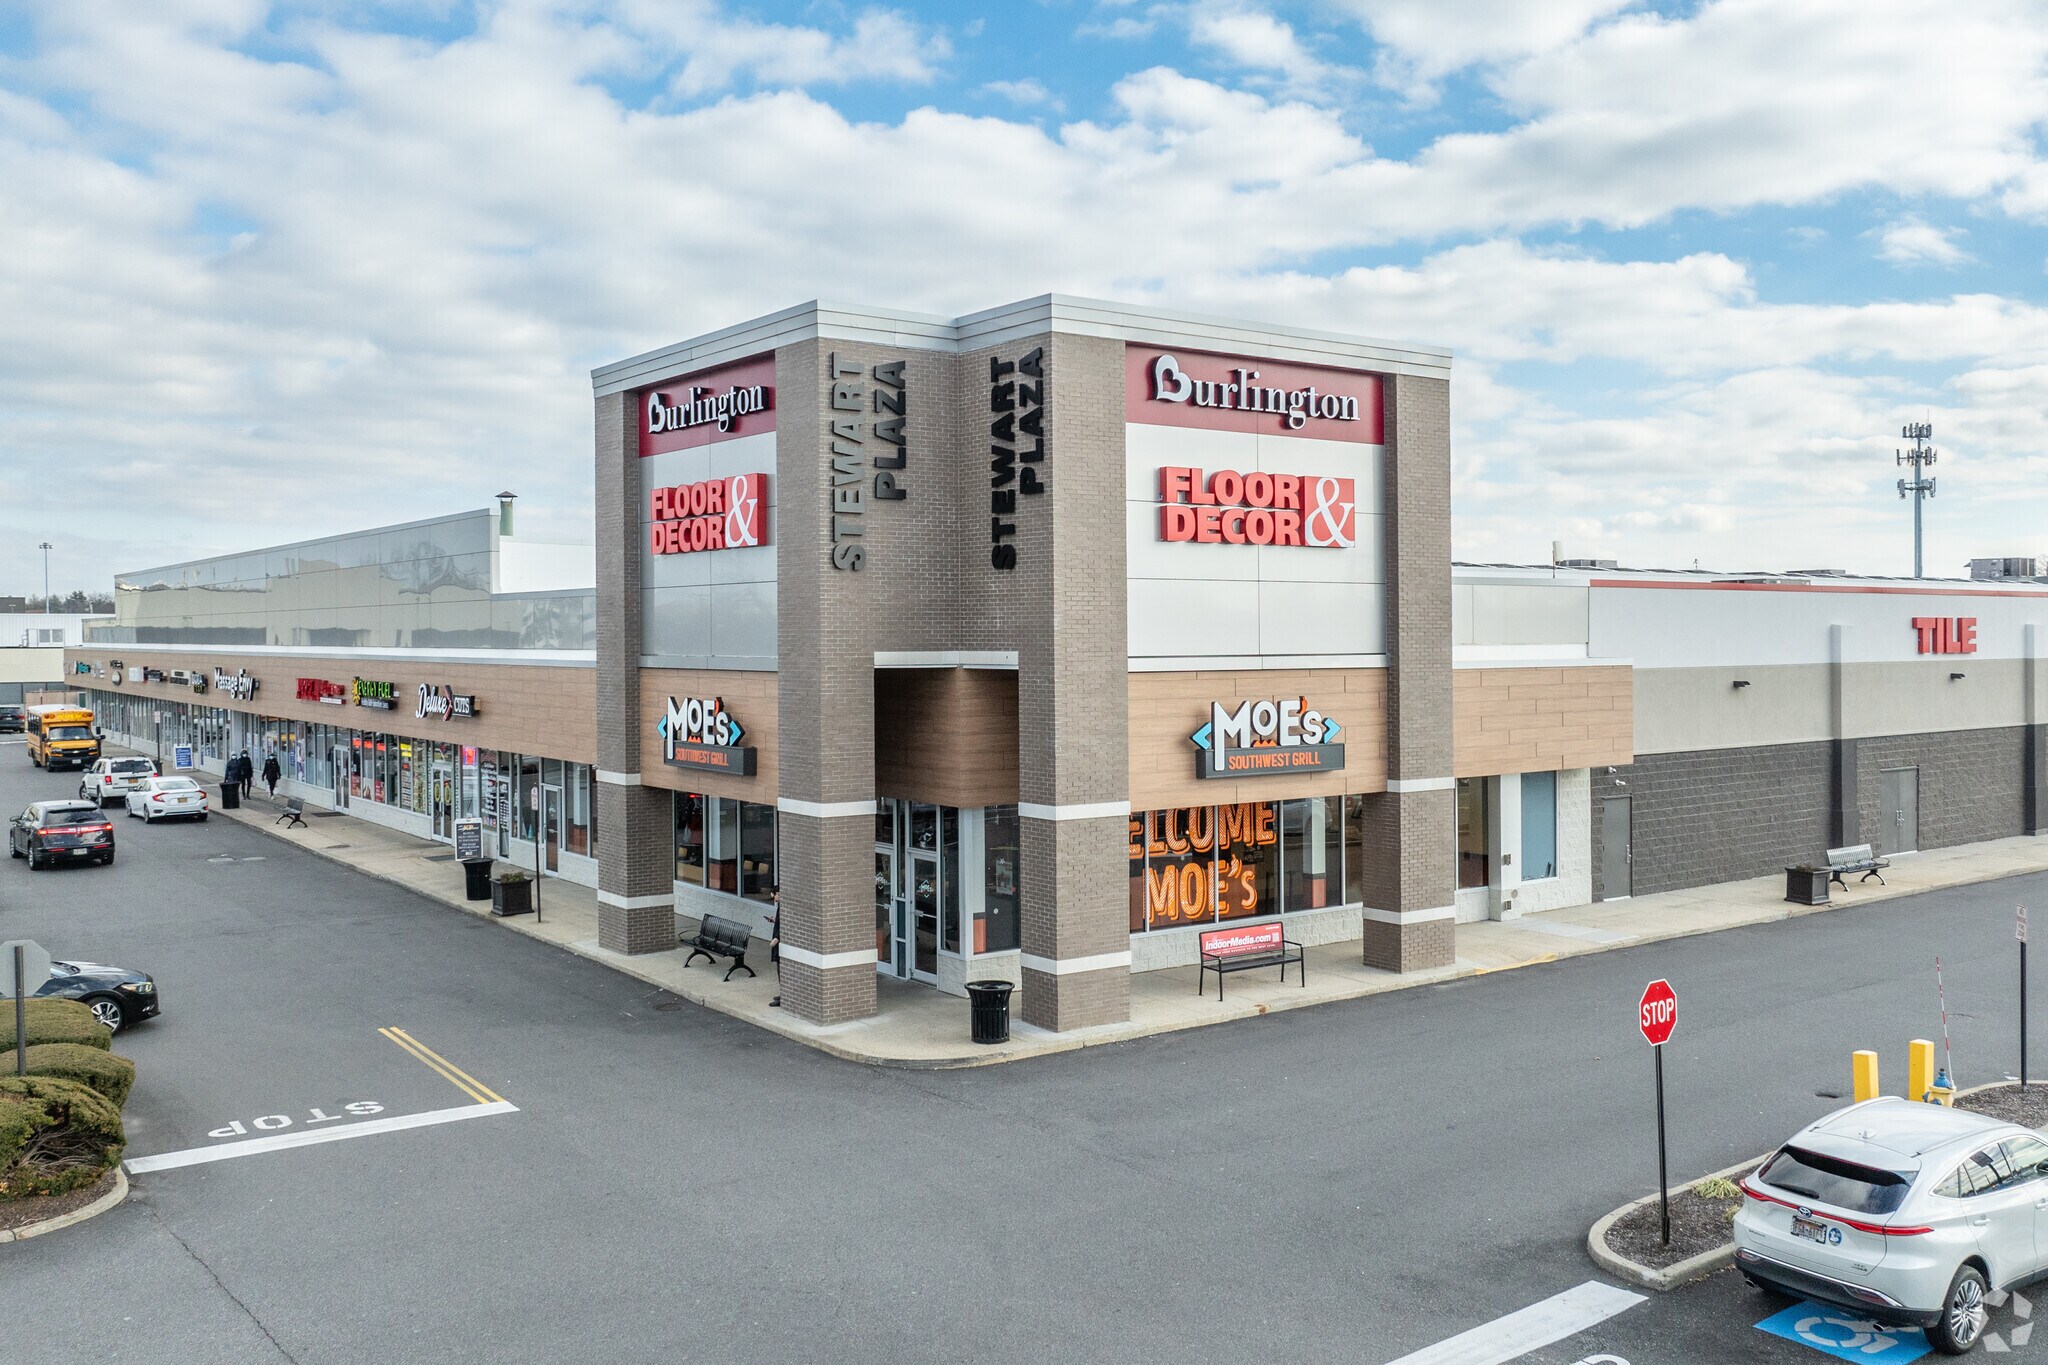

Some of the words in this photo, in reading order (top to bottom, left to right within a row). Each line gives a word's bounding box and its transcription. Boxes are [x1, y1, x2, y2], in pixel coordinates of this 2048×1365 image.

[648, 385, 764, 433] Burlington
[1155, 354, 1360, 429] Burlington
[874, 361, 906, 499] PLAZA
[1019, 347, 1044, 494] PLAZA
[832, 352, 866, 571] STEWART
[991, 356, 1016, 570] STEWART
[651, 480, 724, 520] FLOOR
[725, 475, 758, 547] &
[1160, 466, 1301, 509] FLOOR
[1305, 477, 1355, 547] &
[1161, 505, 1302, 546] DECOR
[651, 516, 724, 555] DECOR
[1912, 617, 1977, 654] TILE
[214, 667, 238, 699] Massage
[238, 668, 254, 701] Envy
[415, 683, 448, 718] Deluxe
[453, 697, 470, 714] CUTS
[1228, 754, 1290, 770] SOUTHWEST
[1205, 934, 1272, 951] IndoorMedia.com
[1642, 998, 1675, 1027] STOP
[207, 1101, 385, 1138] STOP
